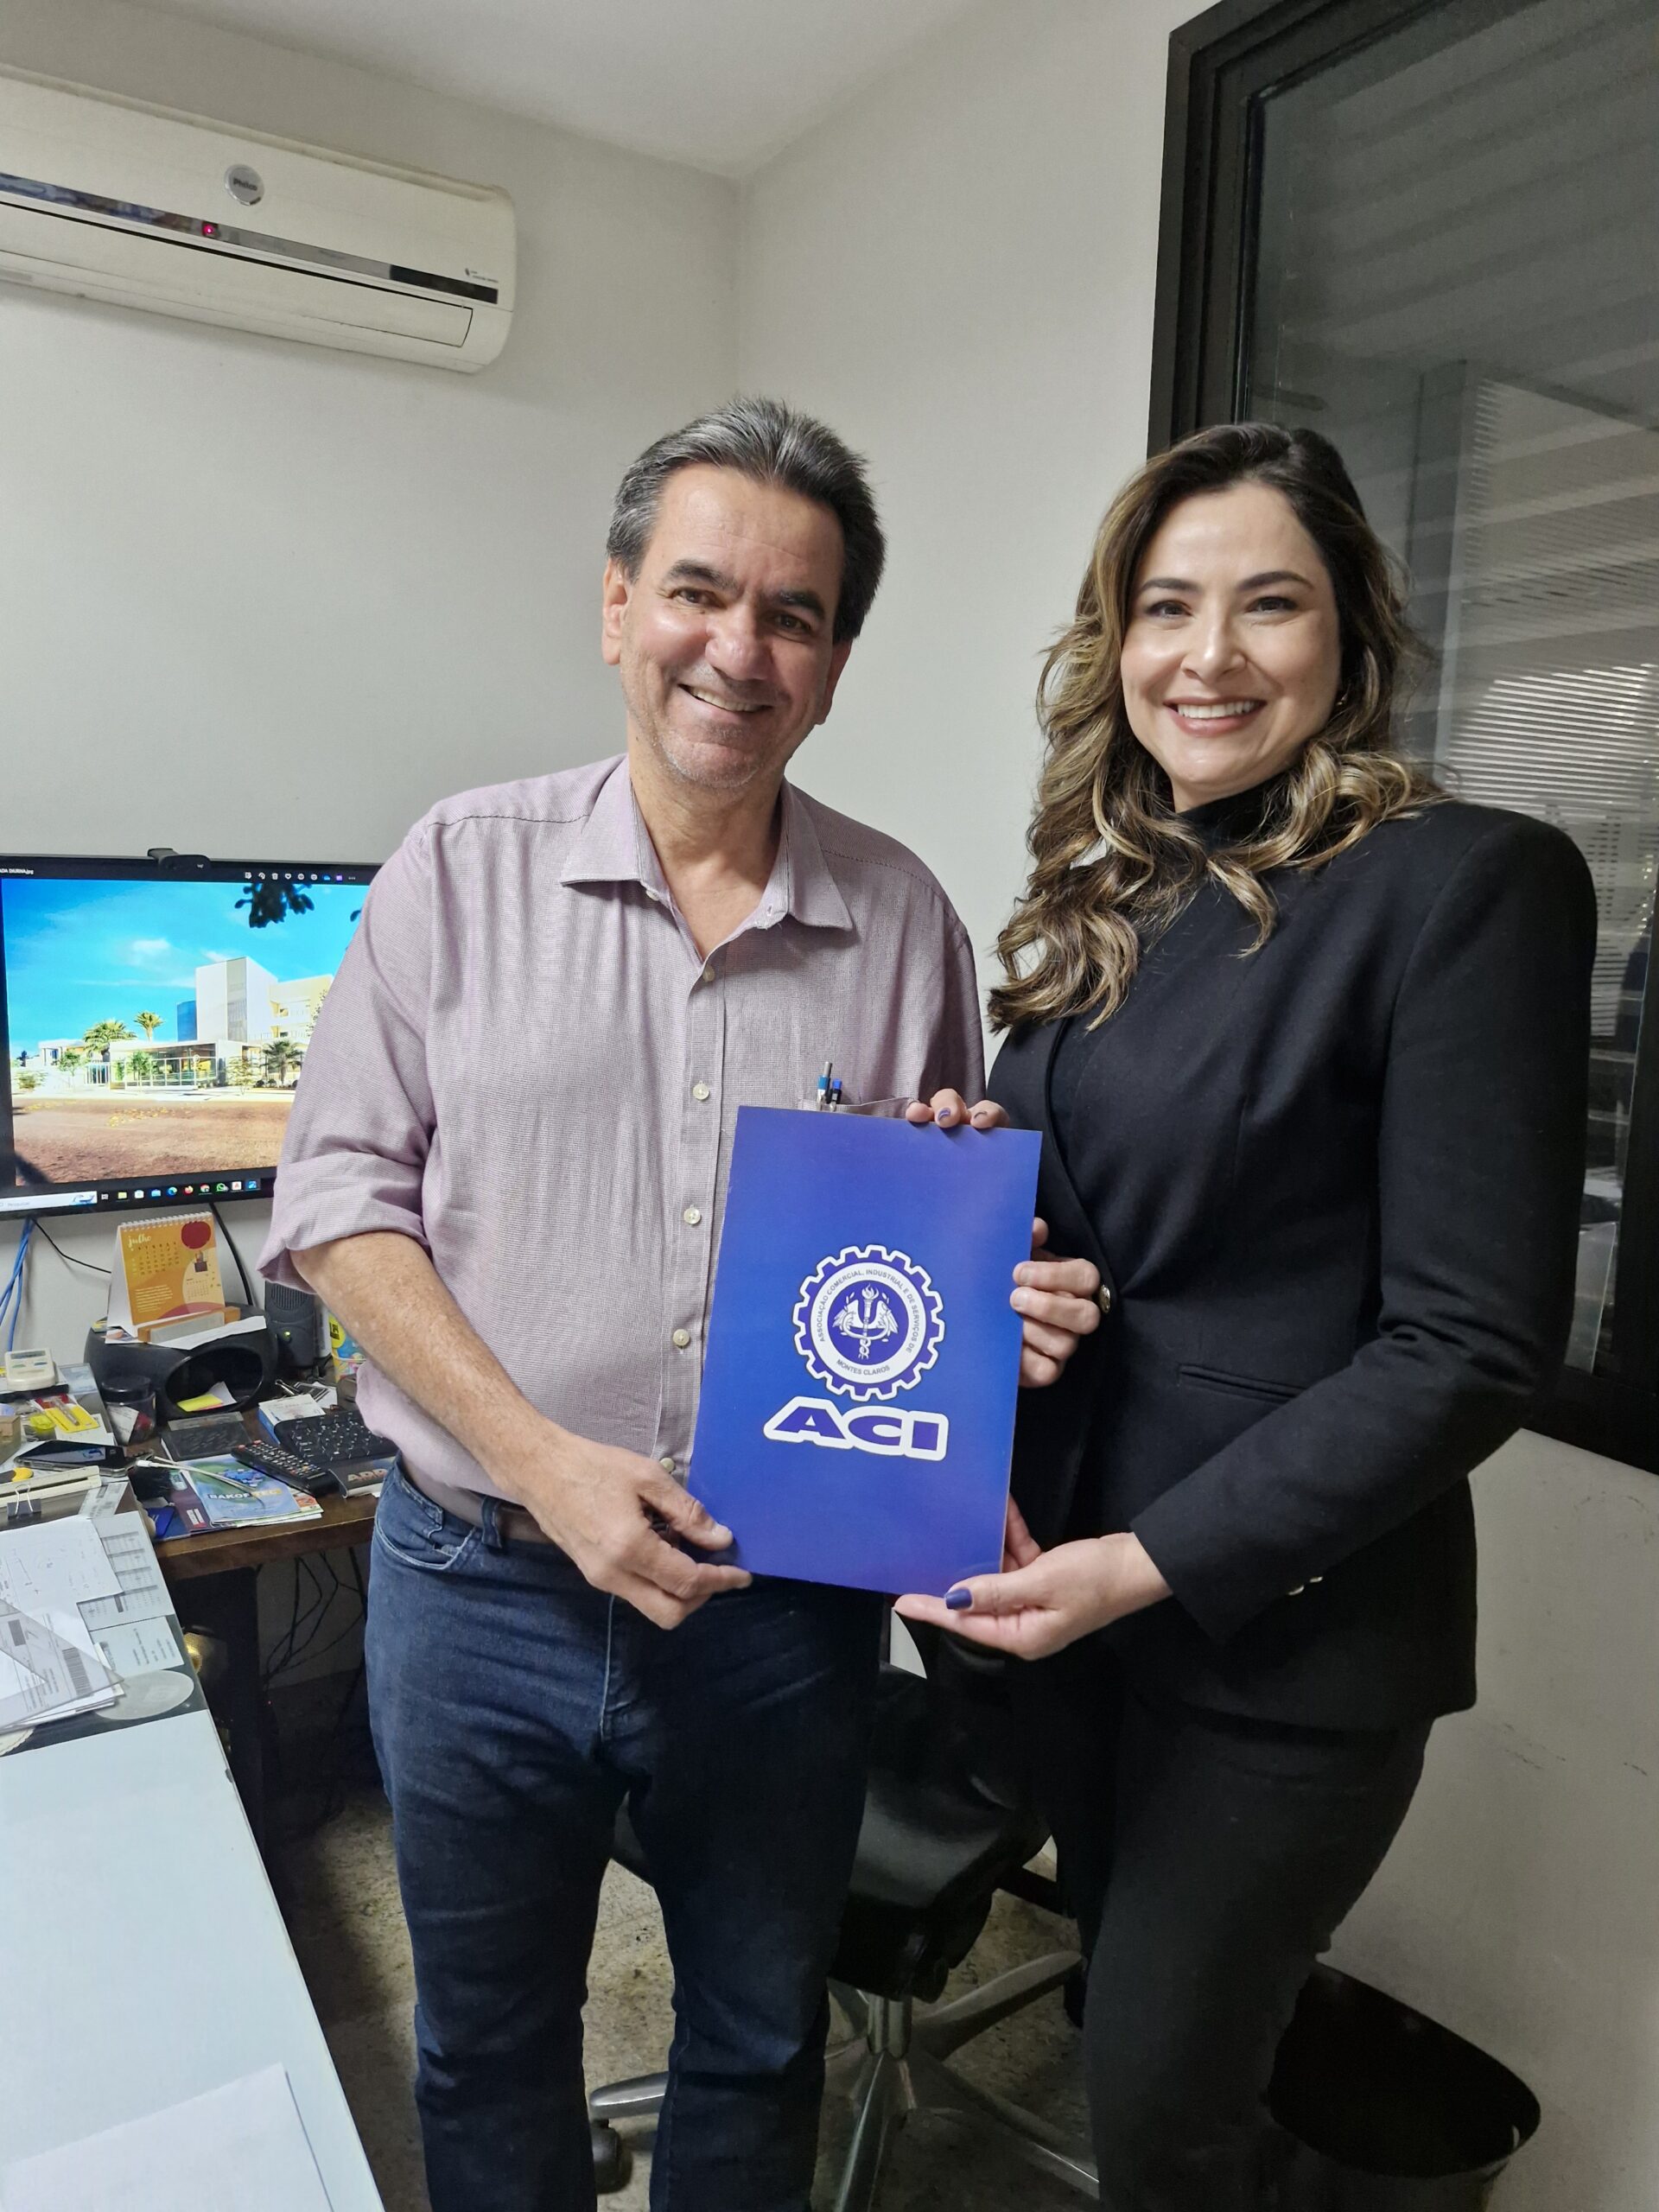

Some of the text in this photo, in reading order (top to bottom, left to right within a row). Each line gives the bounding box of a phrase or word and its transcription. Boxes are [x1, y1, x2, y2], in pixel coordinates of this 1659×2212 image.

[128, 1234, 151, 1249] julho
[817, 1295, 829, 1342] ASSOCIAÇÃO
[866, 1269, 905, 1291] INDUSTRIAL
[906, 1294, 915, 1304] DE
[836, 1359, 891, 1376] MONTES CLAROS
[767, 1401, 945, 1457] ACI
